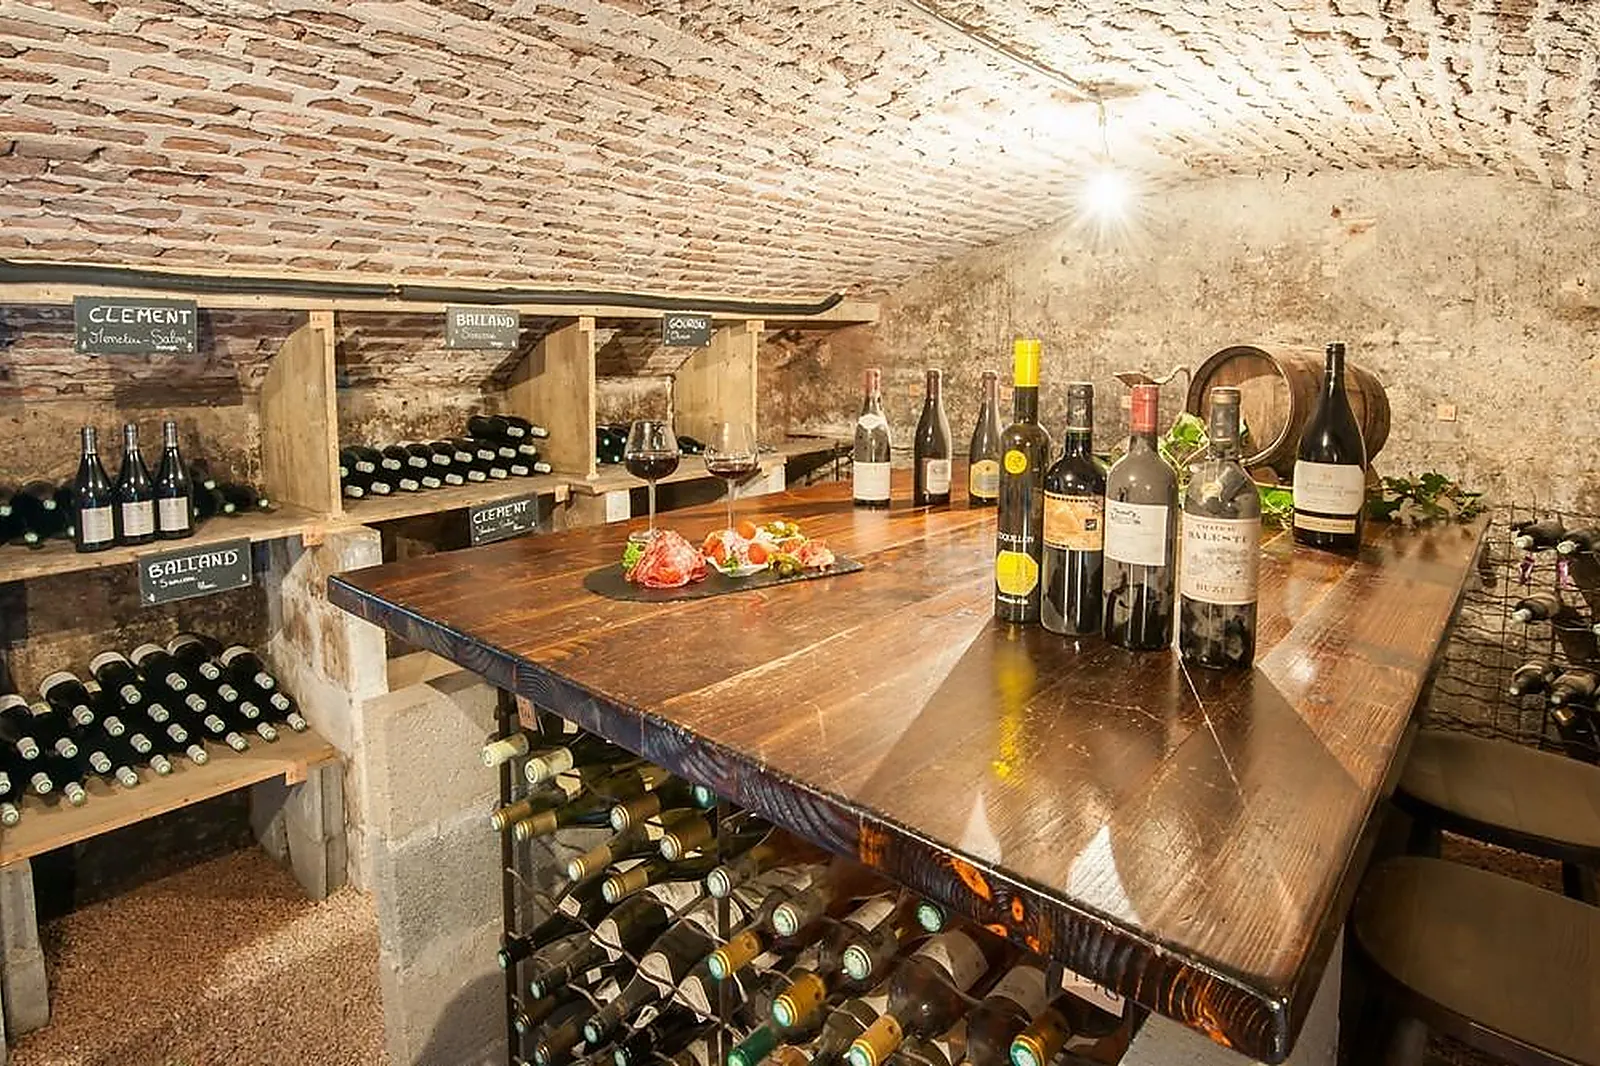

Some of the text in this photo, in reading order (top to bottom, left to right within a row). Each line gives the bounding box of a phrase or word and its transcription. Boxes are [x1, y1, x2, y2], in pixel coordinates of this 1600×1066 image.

[89, 307, 191, 325] CLEMENT
[456, 313, 515, 328] BALLAND
[473, 500, 531, 525] CLEMENT
[148, 549, 238, 578] BALLAND
